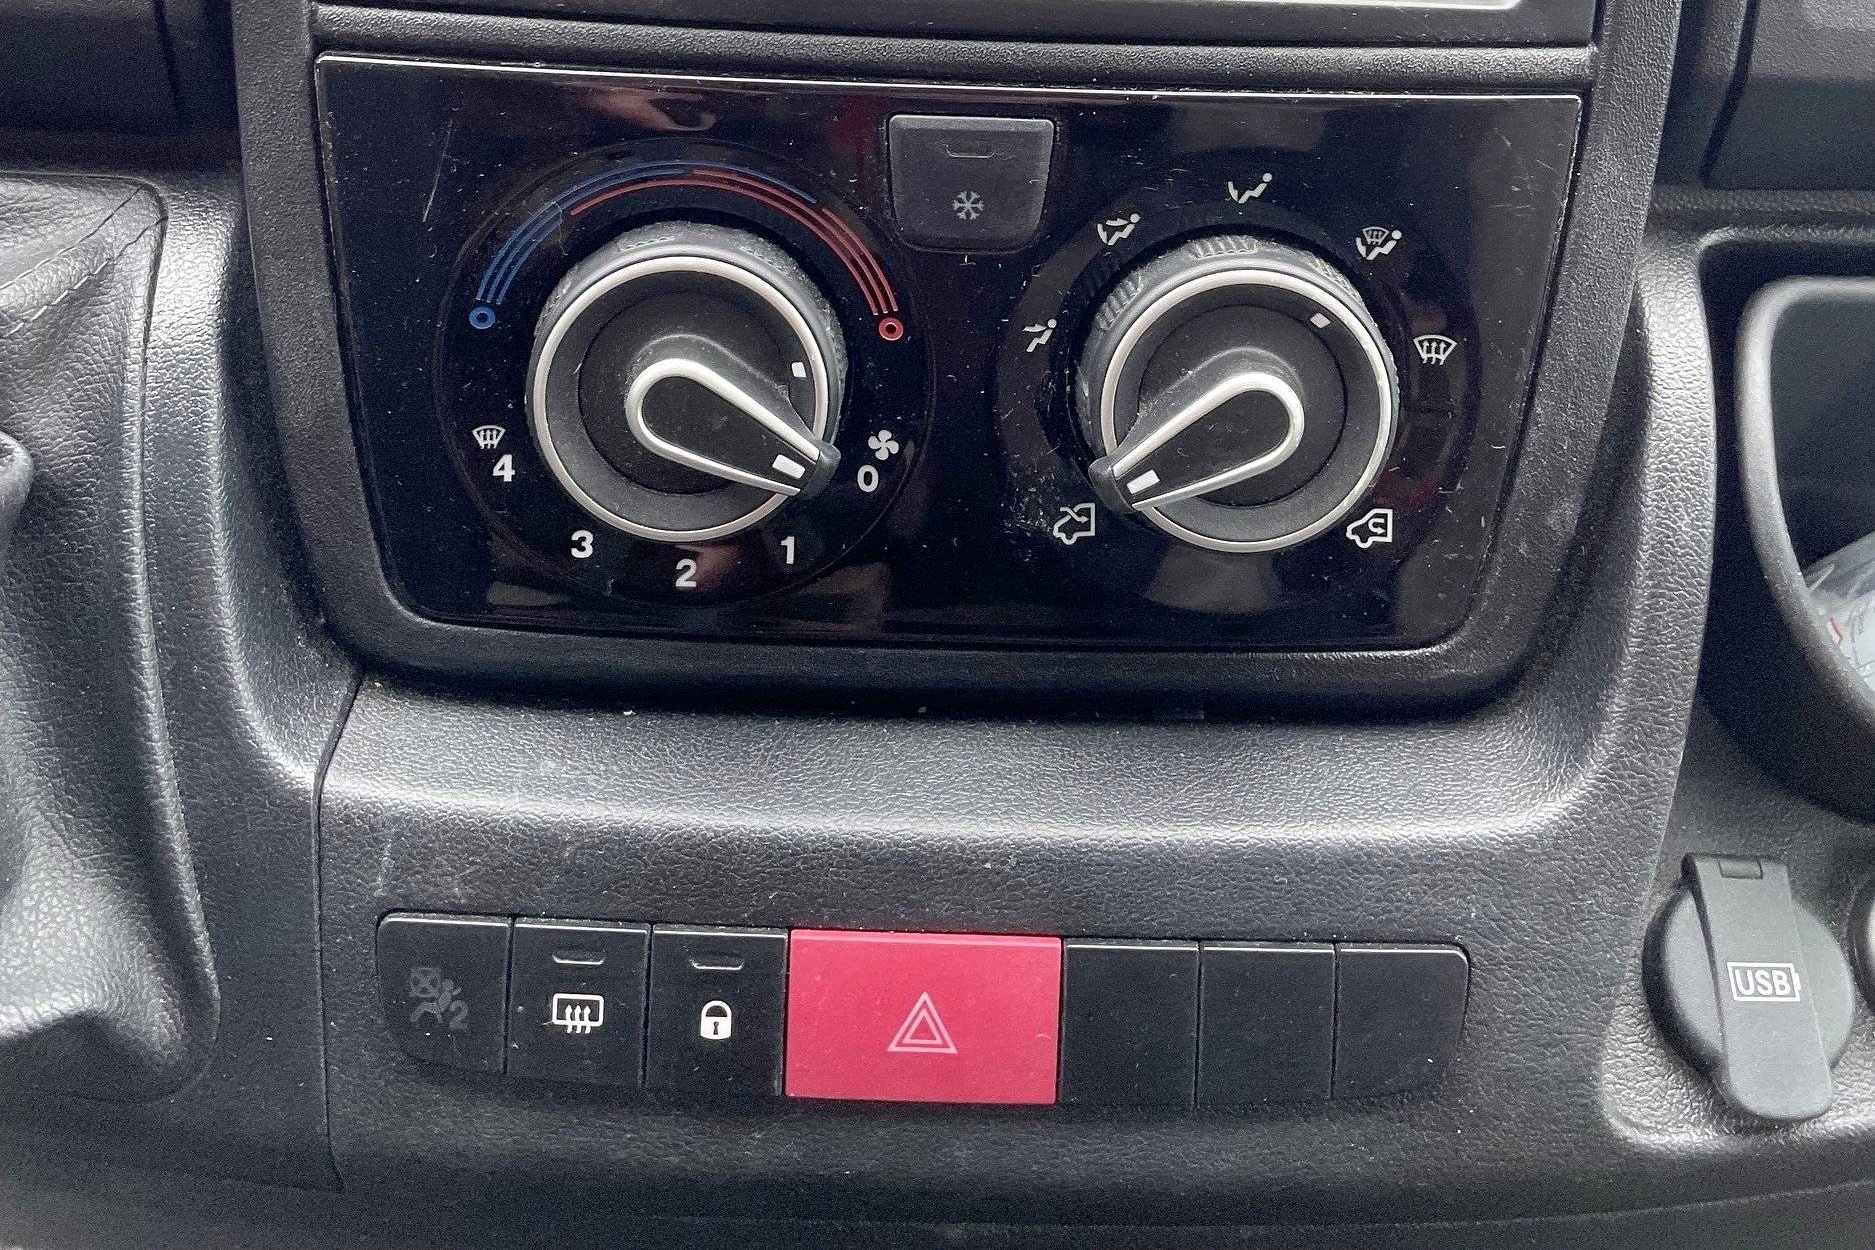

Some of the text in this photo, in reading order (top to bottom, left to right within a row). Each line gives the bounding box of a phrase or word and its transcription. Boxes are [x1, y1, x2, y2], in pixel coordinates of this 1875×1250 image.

[492, 454, 516, 482] 4
[857, 464, 880, 492] 0
[570, 530, 594, 558] 3
[780, 536, 796, 565] 1
[674, 558, 698, 588] 2
[1735, 969, 1791, 996] USB
